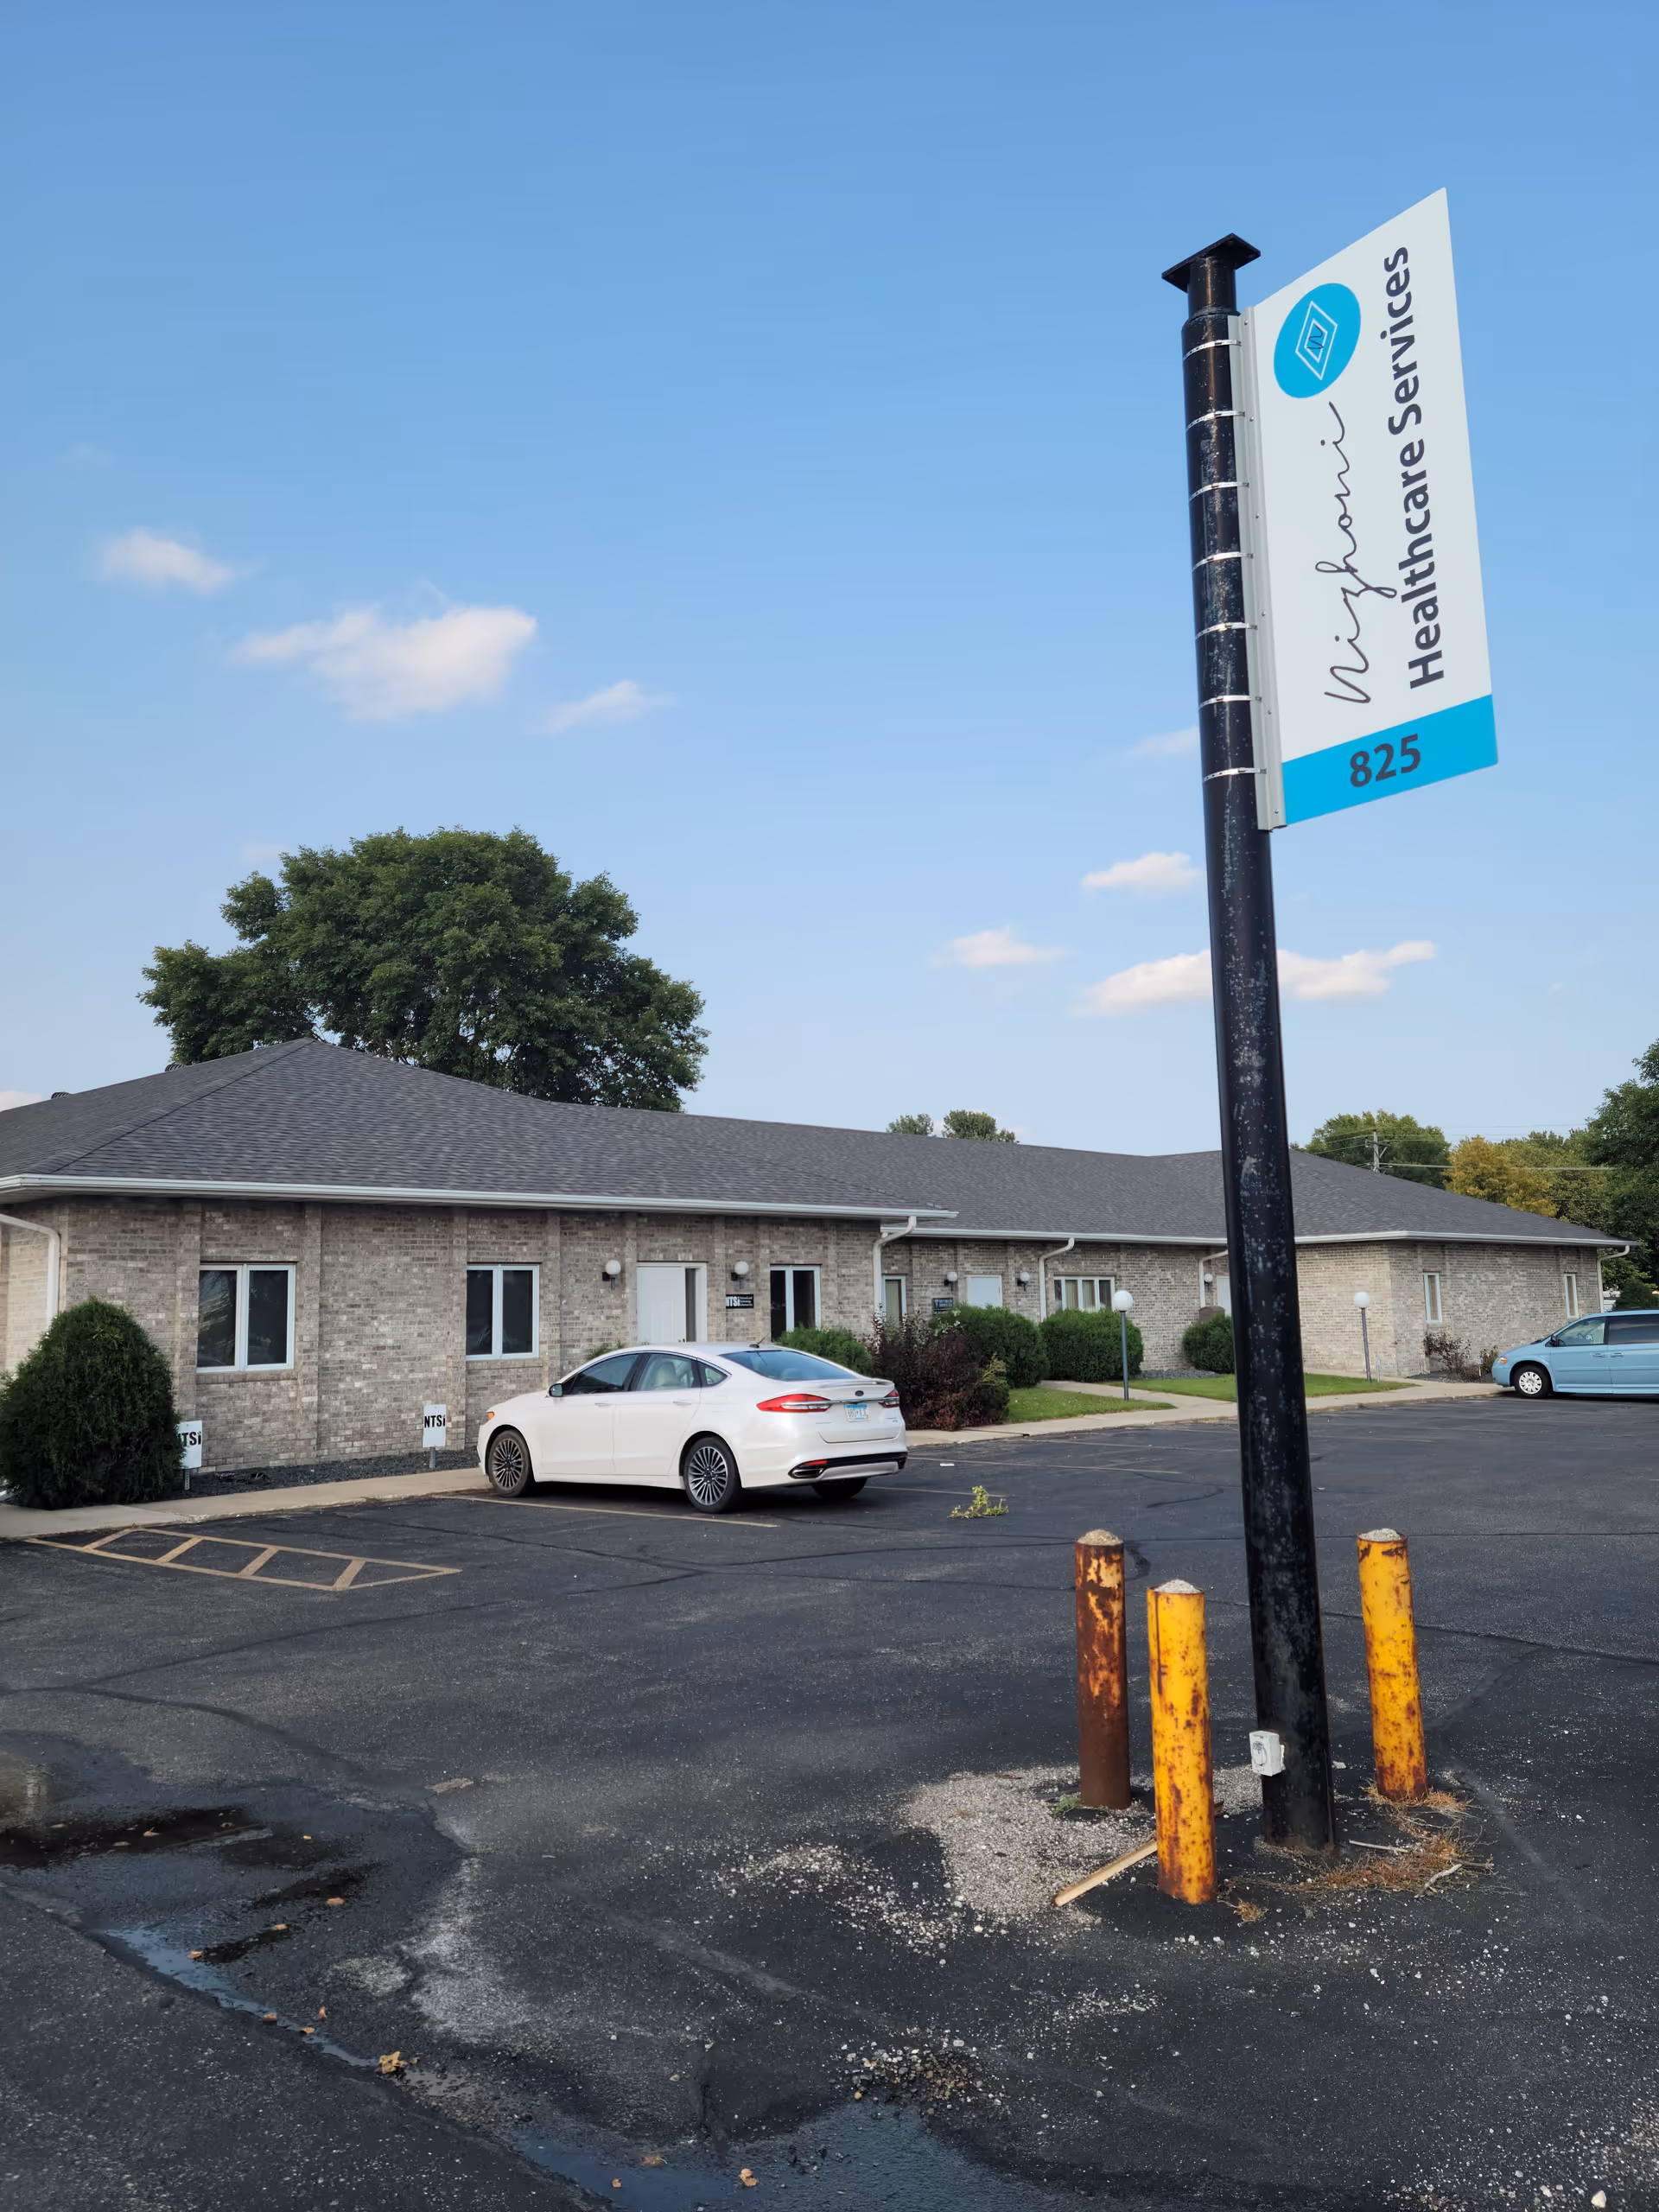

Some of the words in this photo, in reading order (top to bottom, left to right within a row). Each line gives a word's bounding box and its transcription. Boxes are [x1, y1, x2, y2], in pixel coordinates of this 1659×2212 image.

[1380, 246, 1422, 435] Services
[1315, 401, 1397, 703] Nizhoni
[1398, 438, 1445, 690] Healthcare
[1350, 733, 1421, 788] 825
[424, 1414, 446, 1428] NTSi
